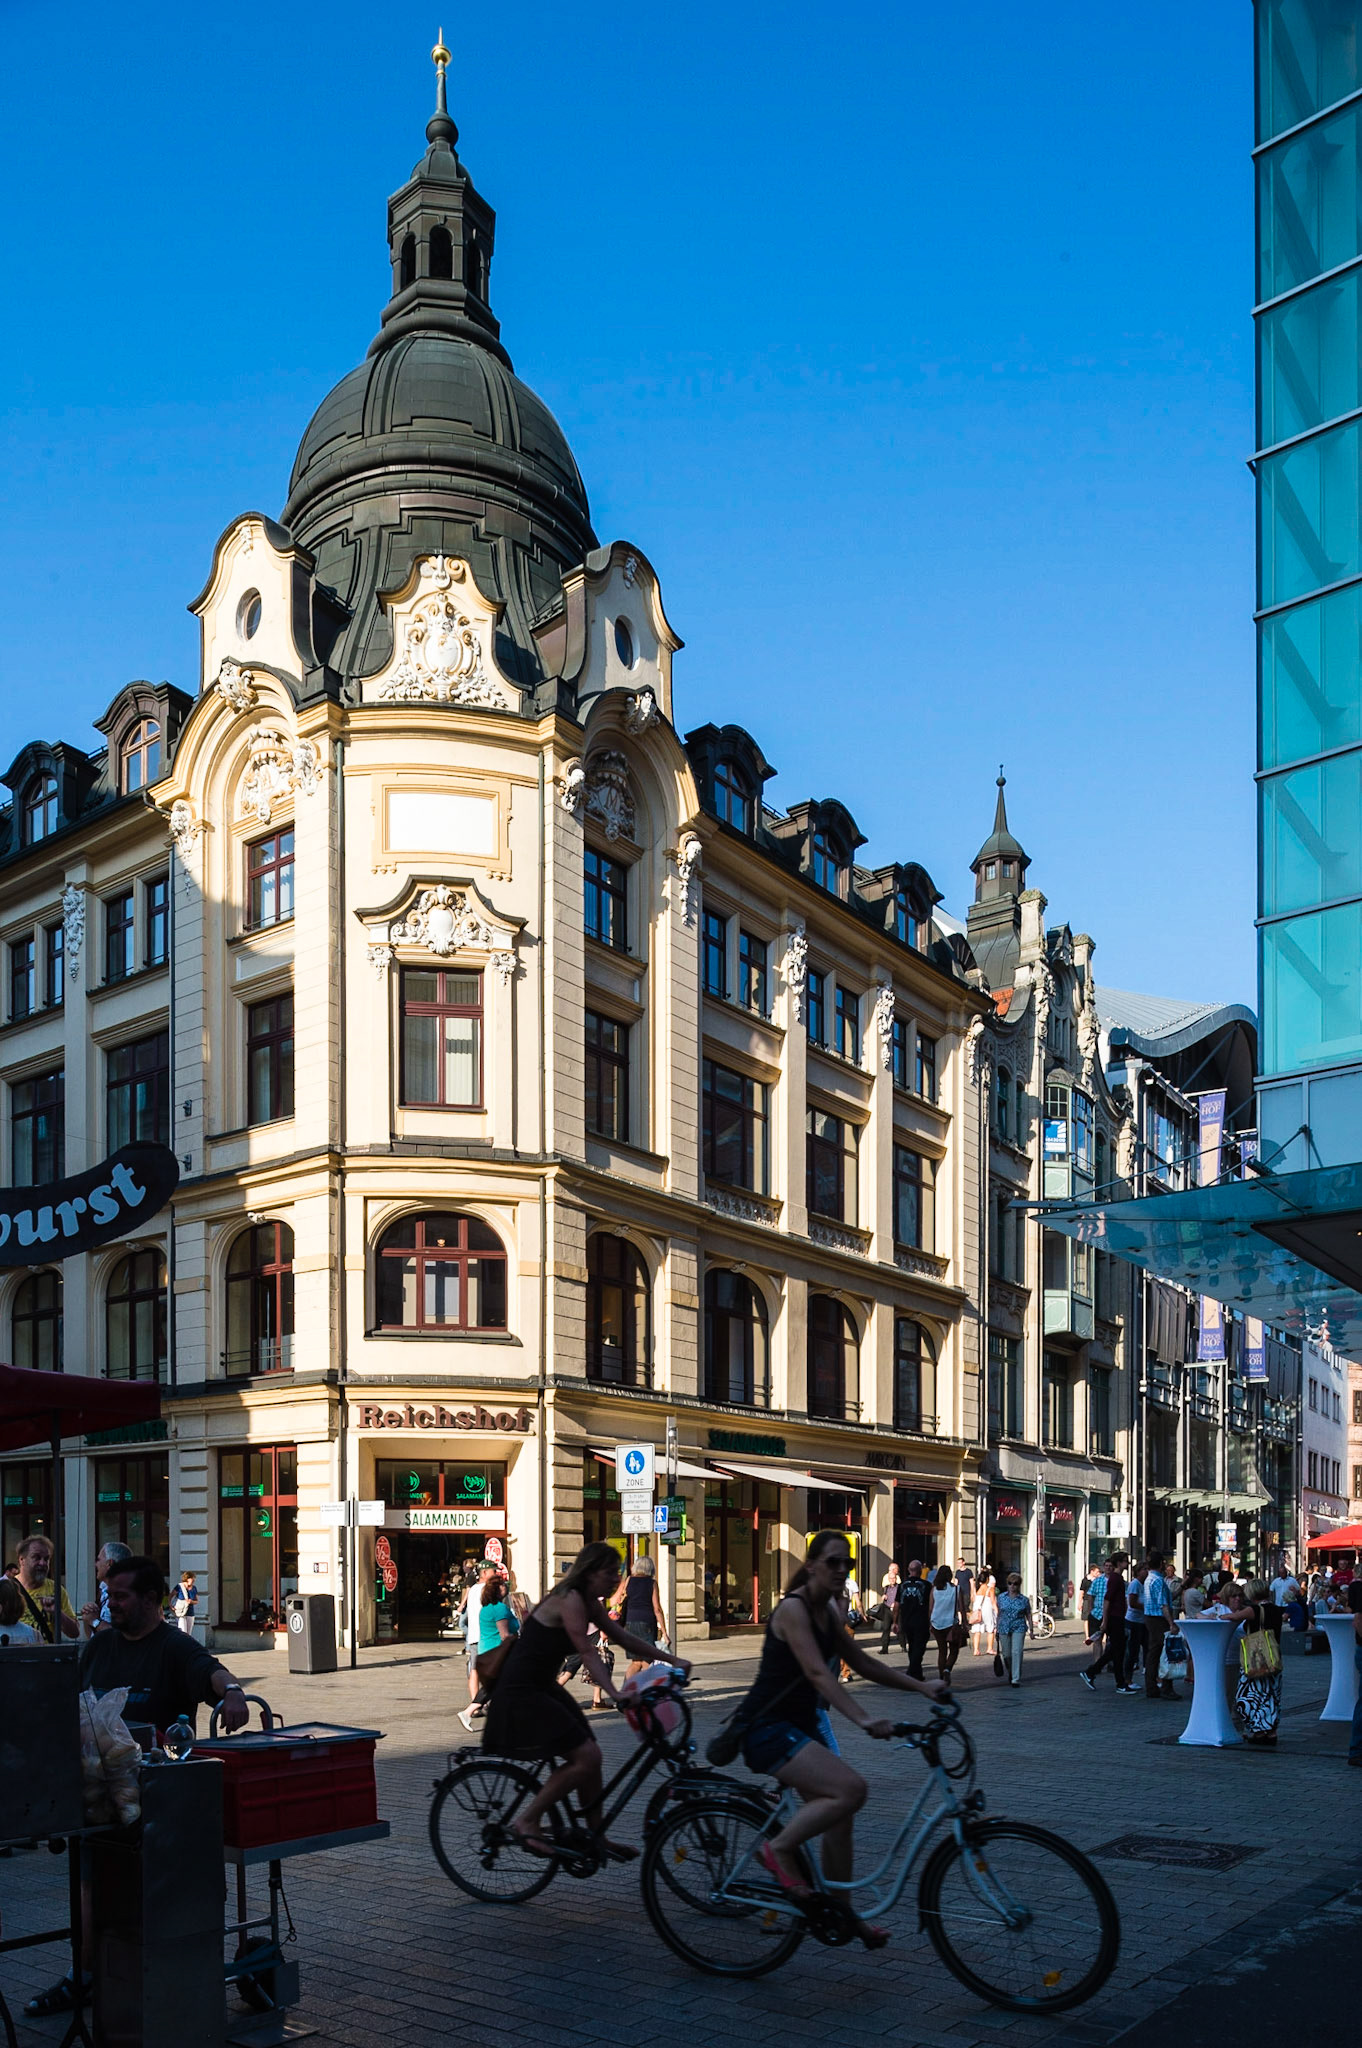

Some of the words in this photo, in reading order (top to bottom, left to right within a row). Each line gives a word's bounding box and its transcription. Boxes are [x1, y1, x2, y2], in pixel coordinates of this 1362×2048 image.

[1202, 1105, 1221, 1115] HOF
[357, 1403, 530, 1431] Reichshof
[626, 1478, 645, 1487] ZONE
[404, 1513, 478, 1526] SALAMANDER
